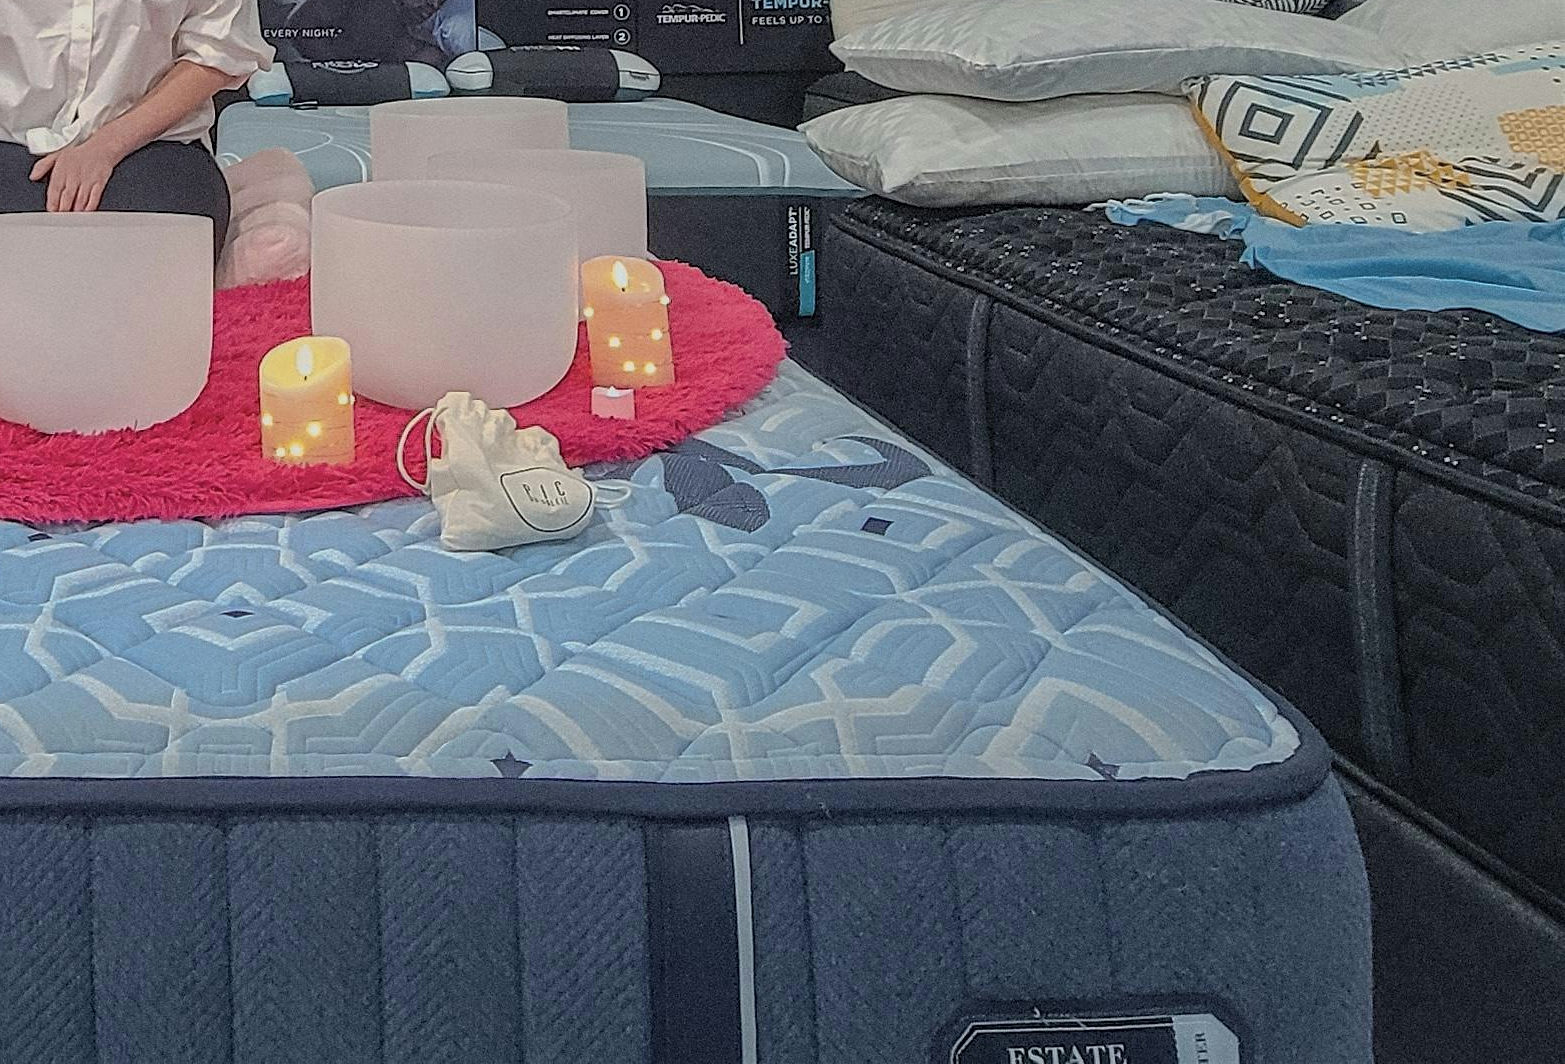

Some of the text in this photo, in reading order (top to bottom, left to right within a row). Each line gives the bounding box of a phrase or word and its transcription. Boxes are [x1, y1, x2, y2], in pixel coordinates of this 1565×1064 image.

[656, 12, 727, 24] TEMPUR-PEDIC
[751, 15, 823, 26] FEELS UP TO
[263, 28, 299, 38] EVERY
